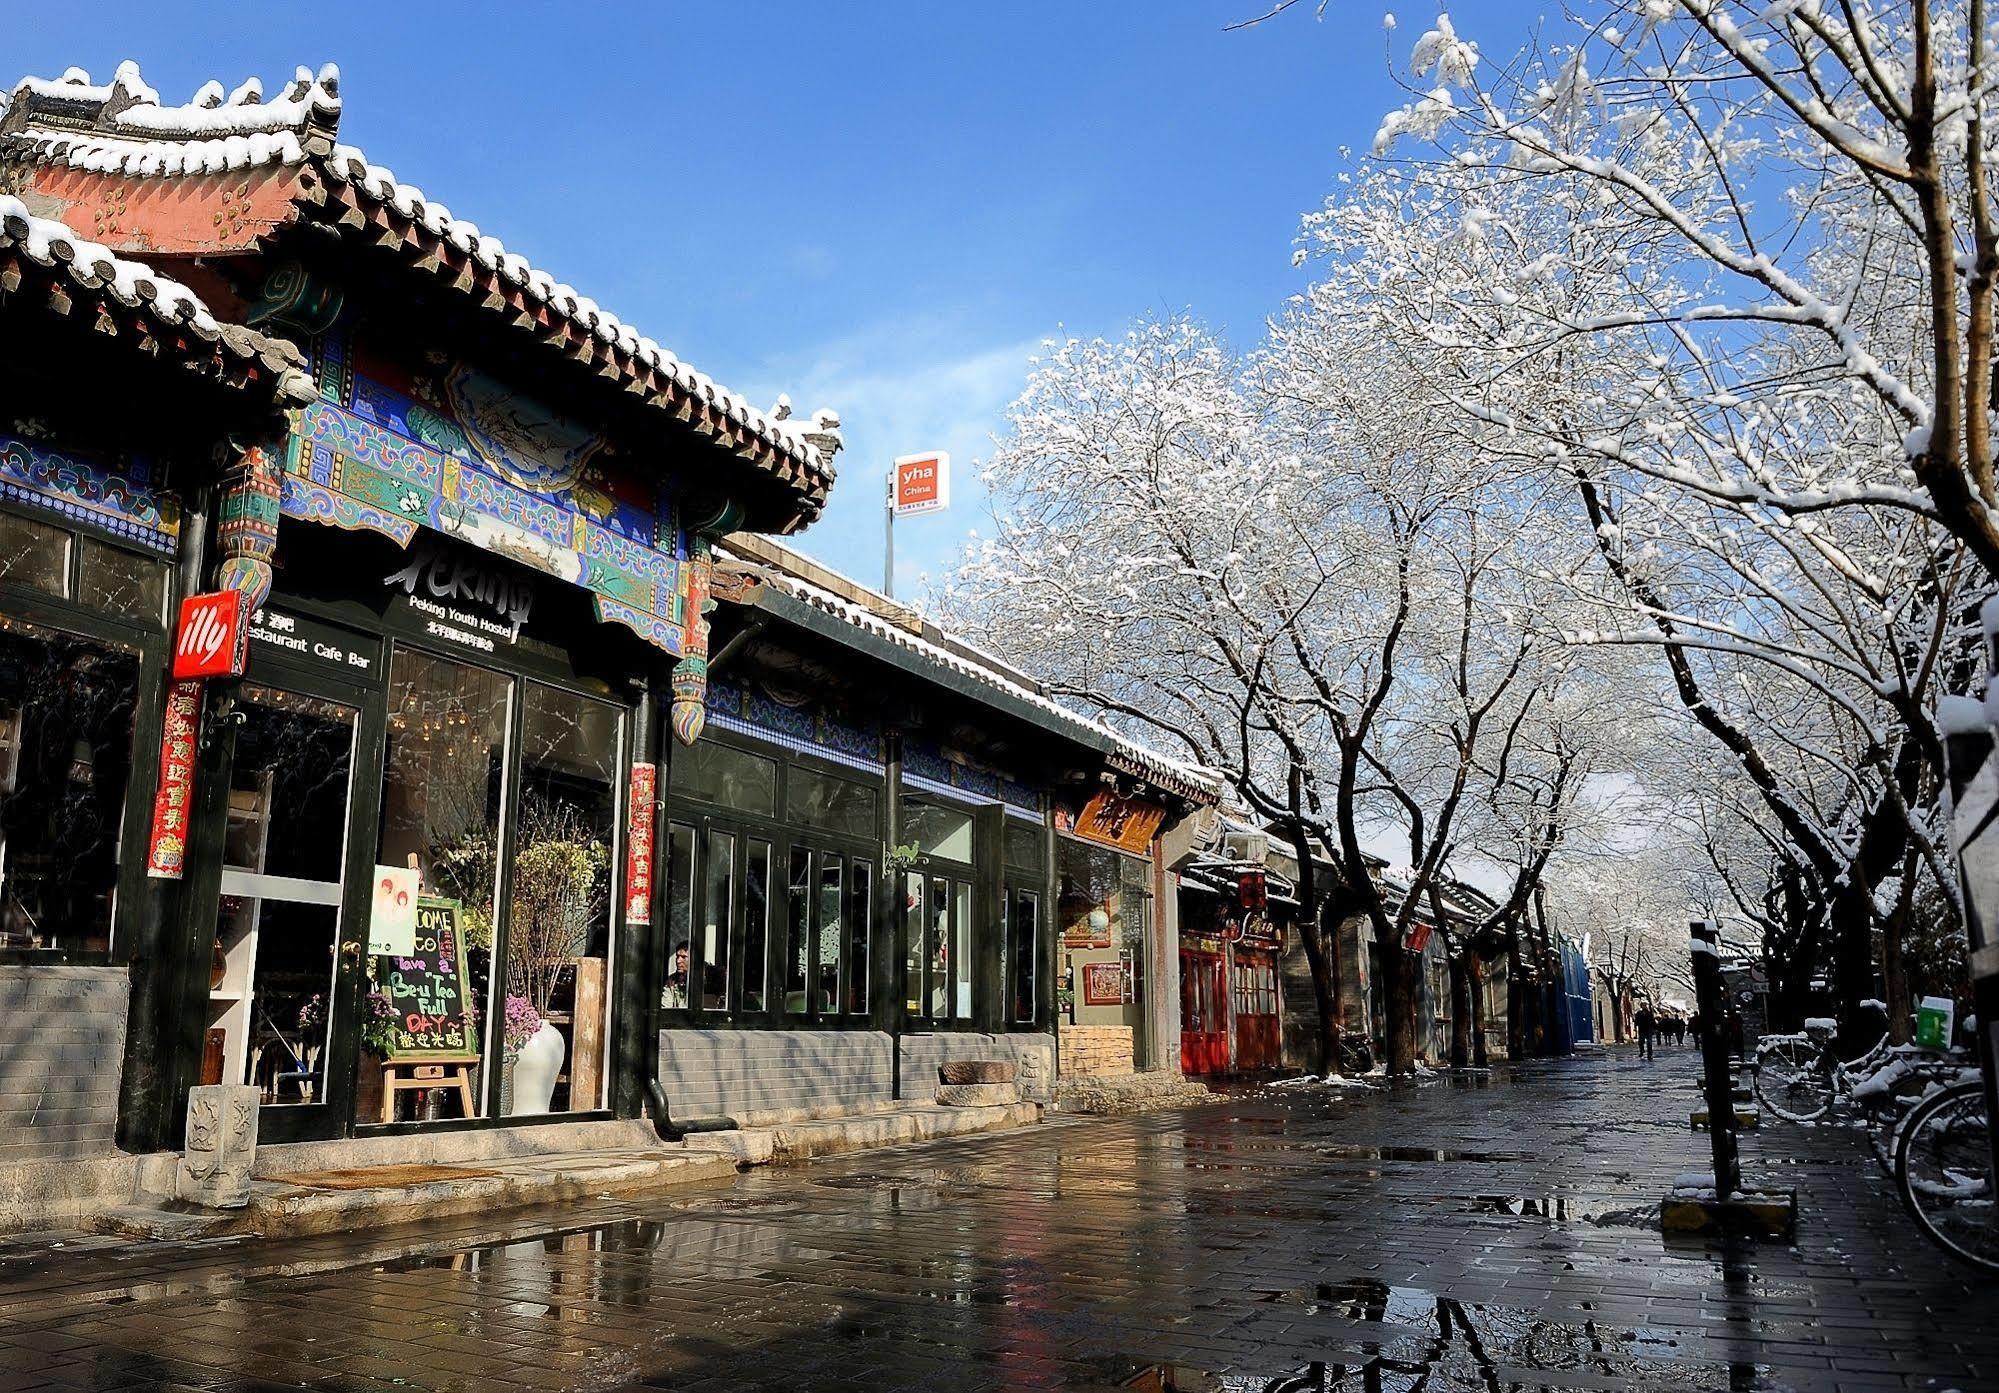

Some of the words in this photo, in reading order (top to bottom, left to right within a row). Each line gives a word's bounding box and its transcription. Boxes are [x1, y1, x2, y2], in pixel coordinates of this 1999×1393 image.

[904, 467, 933, 484] yha
[904, 486, 931, 496] China
[409, 595, 446, 619] Peking
[448, 607, 478, 628] Youth
[480, 617, 511, 639] Hostel
[179, 605, 228, 666] illy
[248, 625, 308, 653] estaurant
[314, 642, 342, 662] Cafe
[348, 651, 370, 668] Bar
[416, 908, 452, 931] COME
[415, 937, 437, 952] to
[438, 959, 453, 973] a
[417, 998, 448, 1016] Full
